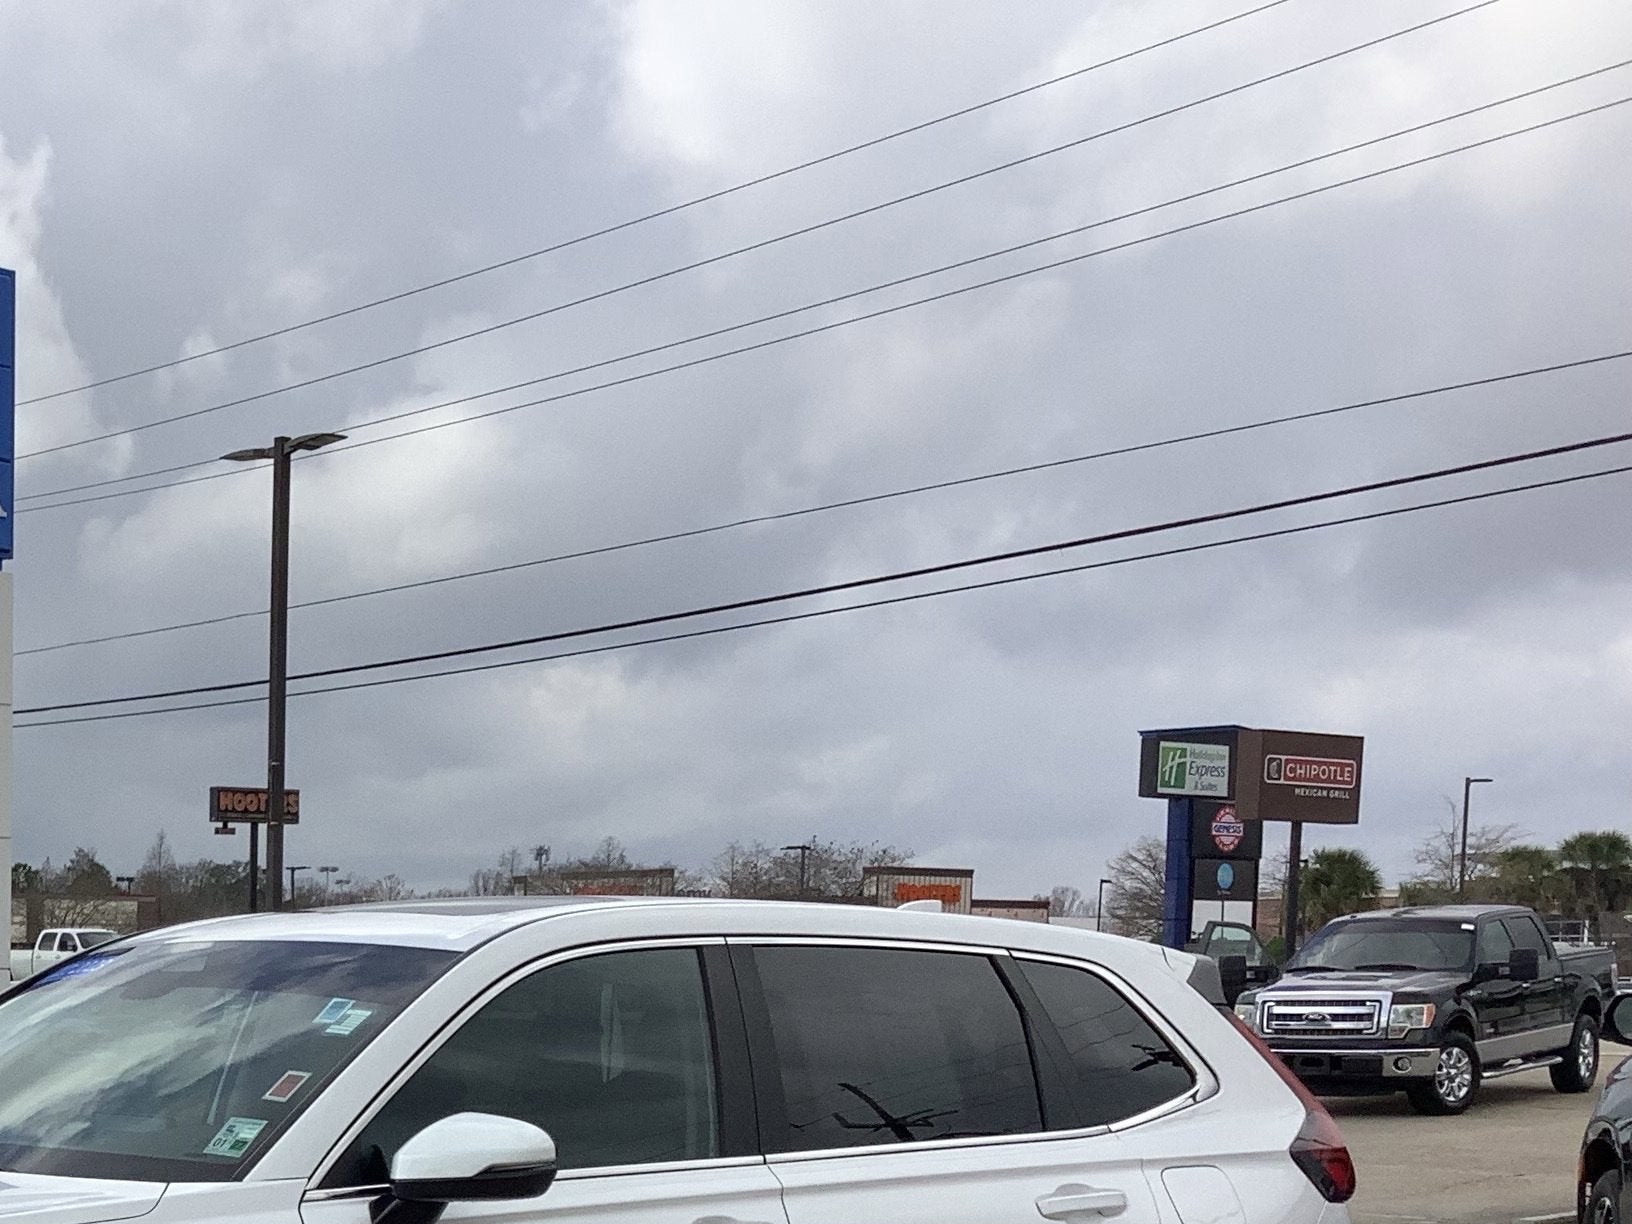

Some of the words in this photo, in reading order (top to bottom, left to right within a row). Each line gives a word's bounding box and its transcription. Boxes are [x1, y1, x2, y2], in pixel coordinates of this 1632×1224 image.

[1188, 760, 1226, 780] Express
[1286, 763, 1352, 781] CHIPOTLE
[1294, 787, 1328, 798] MEXICAN
[1329, 789, 1350, 799] GRILL
[219, 791, 298, 813] HOOTS
[1213, 824, 1242, 835] GENESIS
[213, 1137, 228, 1148] 01
